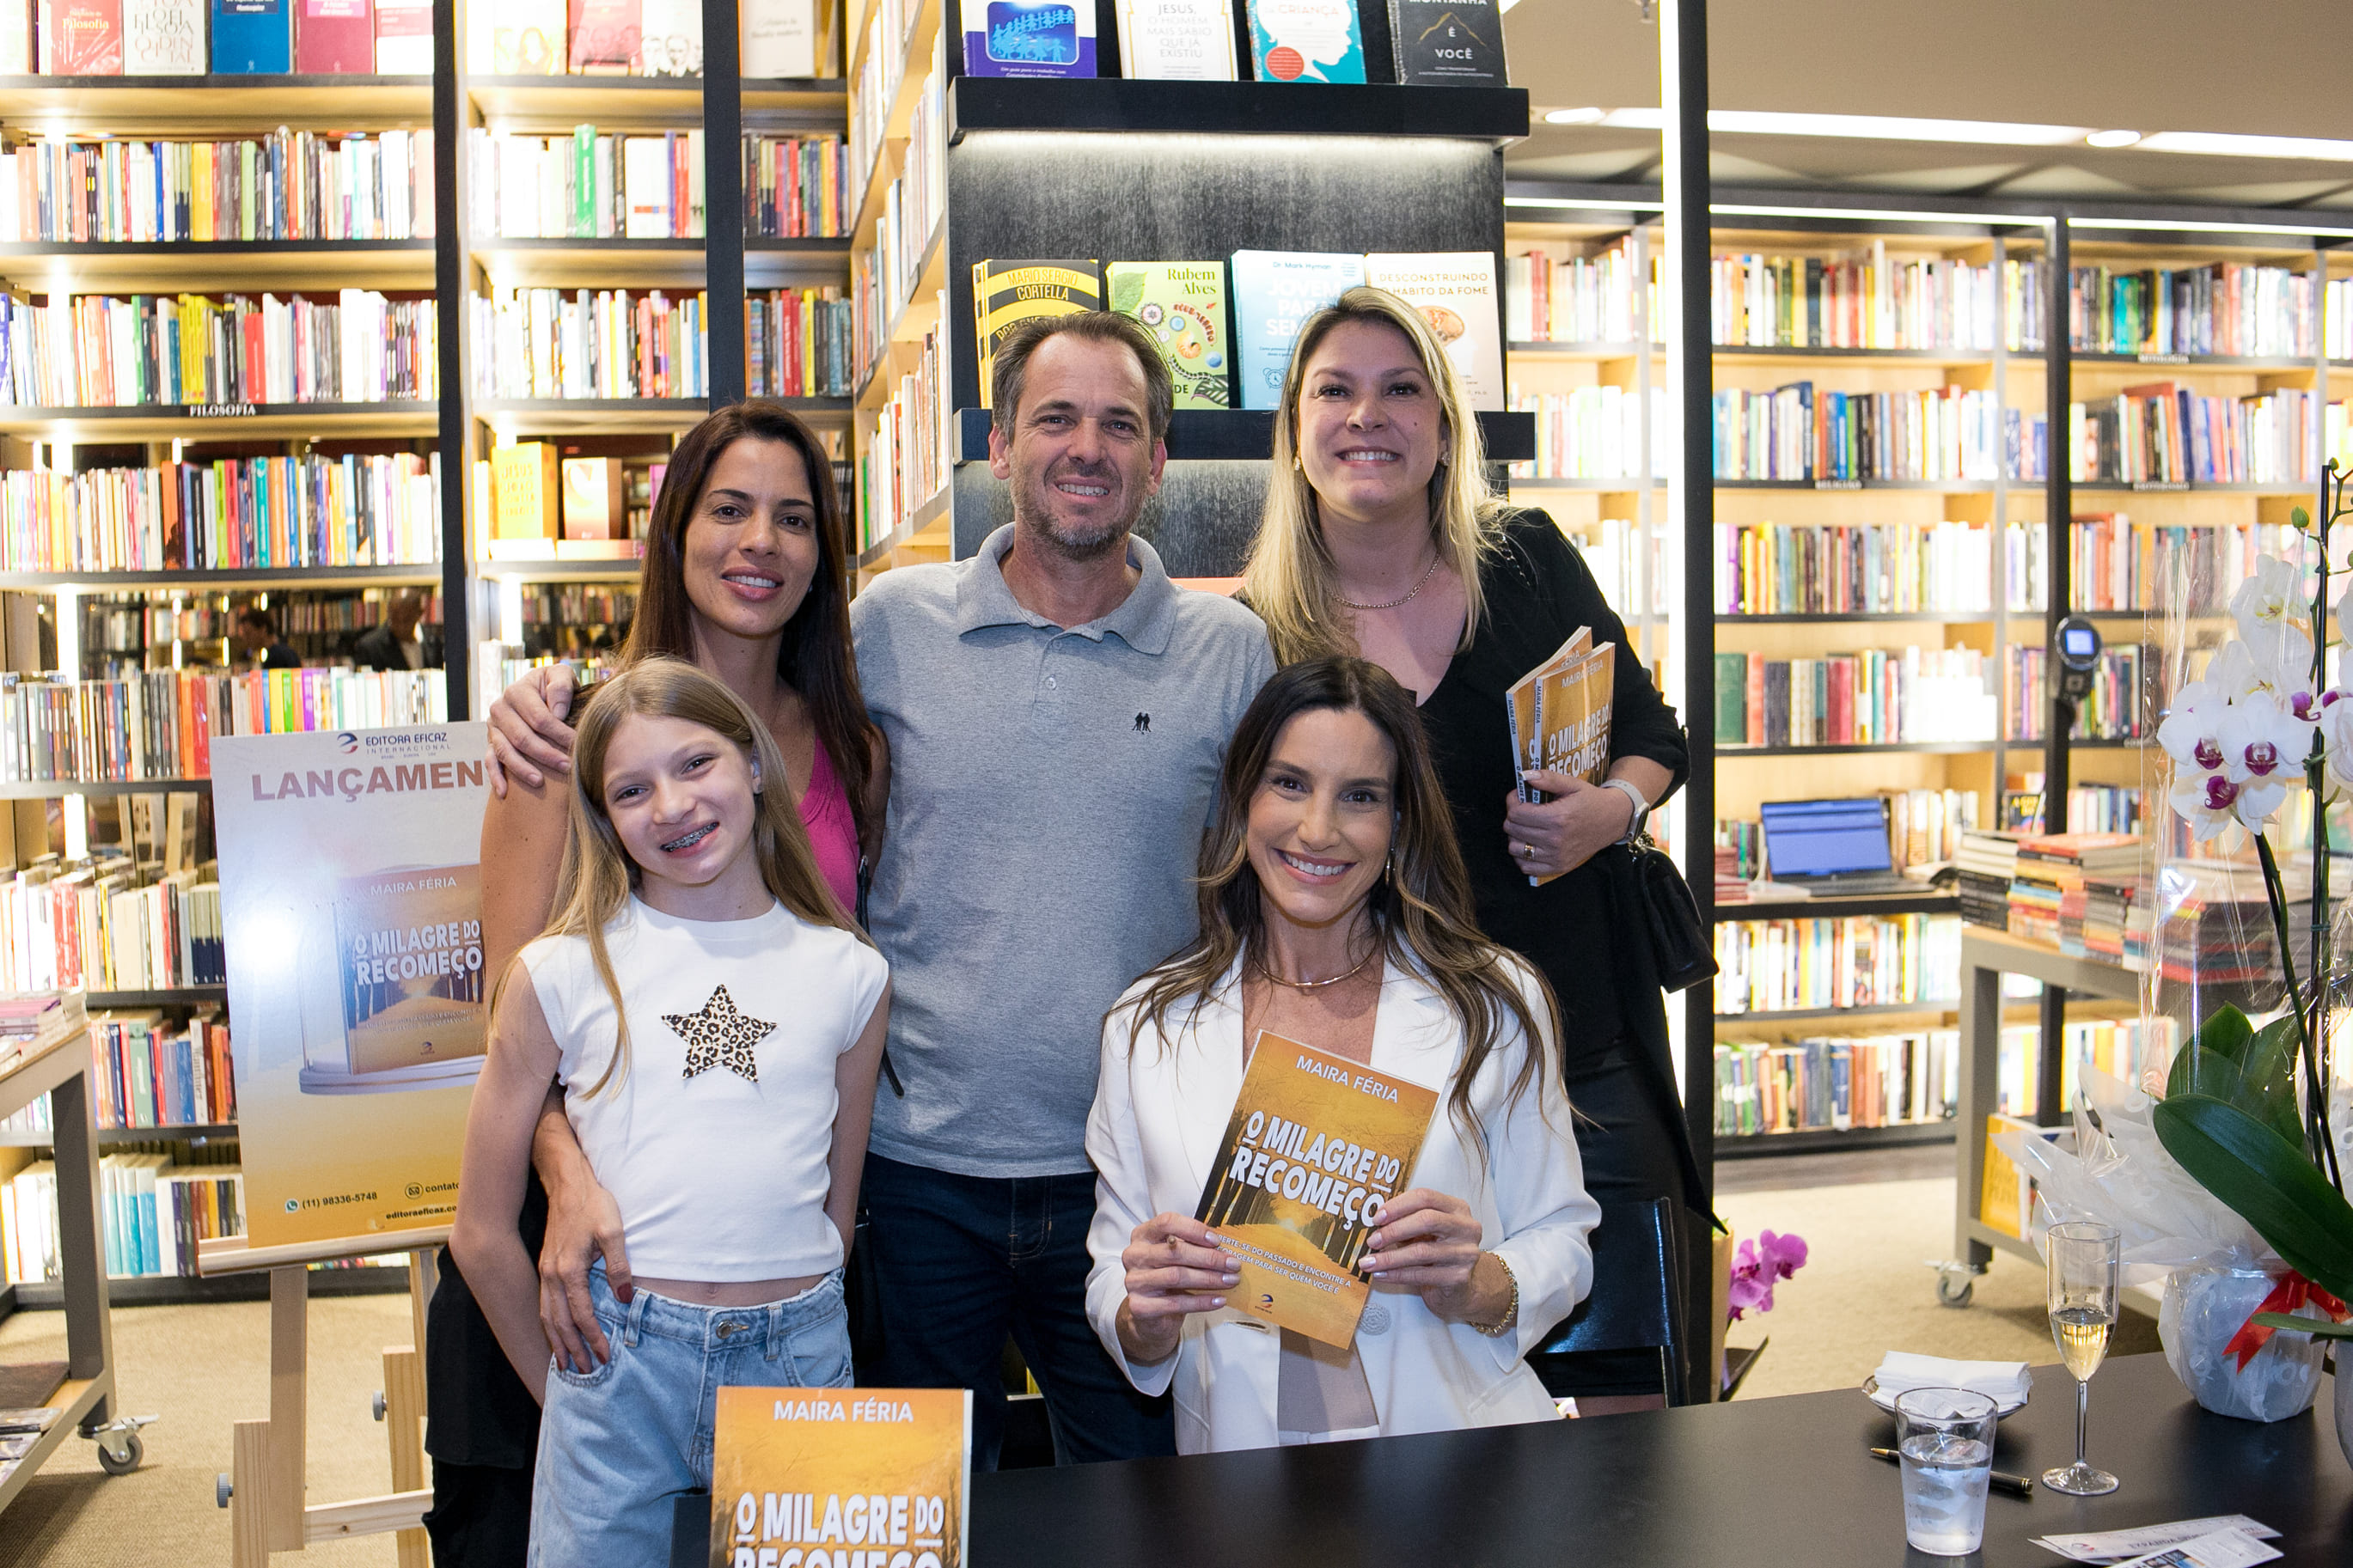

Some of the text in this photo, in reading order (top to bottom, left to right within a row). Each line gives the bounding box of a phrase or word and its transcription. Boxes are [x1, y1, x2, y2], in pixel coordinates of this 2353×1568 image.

[1158, 3, 1197, 15] JESUS,
[1279, 3, 1339, 16] CRIANÇA
[62, 17, 109, 29] Filosofia
[1161, 15, 1207, 25] HOMEM
[1146, 27, 1176, 36] MAIS
[1159, 38, 1186, 48] QUE
[1160, 49, 1203, 58] EXISTIU
[1434, 47, 1473, 59] VOCÊ
[1007, 268, 1078, 287] MARIO SERGIO
[1167, 268, 1215, 281] Rubem
[1379, 272, 1488, 282] DESCONSTRUINDO
[1016, 284, 1069, 302] CORTELLA
[1182, 282, 1217, 296] Alves
[1439, 287, 1454, 296] DA
[1458, 286, 1488, 296] FOME
[190, 404, 257, 418] FILOSOFIA
[1562, 659, 1604, 688] MAIRA FÉRIA
[365, 732, 447, 747] EDITORA EFICAZ
[1558, 708, 1601, 757] MILAGRE
[366, 743, 451, 755] INTERNACIONAL
[370, 876, 457, 896] MAIRA FÉRIA
[354, 918, 480, 957] O MILAGRE DO
[356, 946, 482, 986] RECOMEÇO
[1295, 1054, 1399, 1104] MAIRA FÉRIA
[1246, 1110, 1401, 1185] O MILAGRE DO
[1228, 1144, 1385, 1231] RECOMEÇO
[302, 1198, 321, 1210] (11)
[322, 1191, 377, 1206] 98336-5748
[1251, 1246, 1263, 1256] DO
[1263, 1251, 1298, 1268] PASSADO
[1305, 1266, 1345, 1285] ENCONTRE
[1345, 1279, 1351, 1288] A
[1254, 1259, 1273, 1272] PARA
[1274, 1266, 1288, 1277] SER
[1289, 1272, 1311, 1285] QUEM
[773, 1395, 914, 1424] MAIRA FÉRIA
[736, 1491, 945, 1547] O MILAGRE DO
